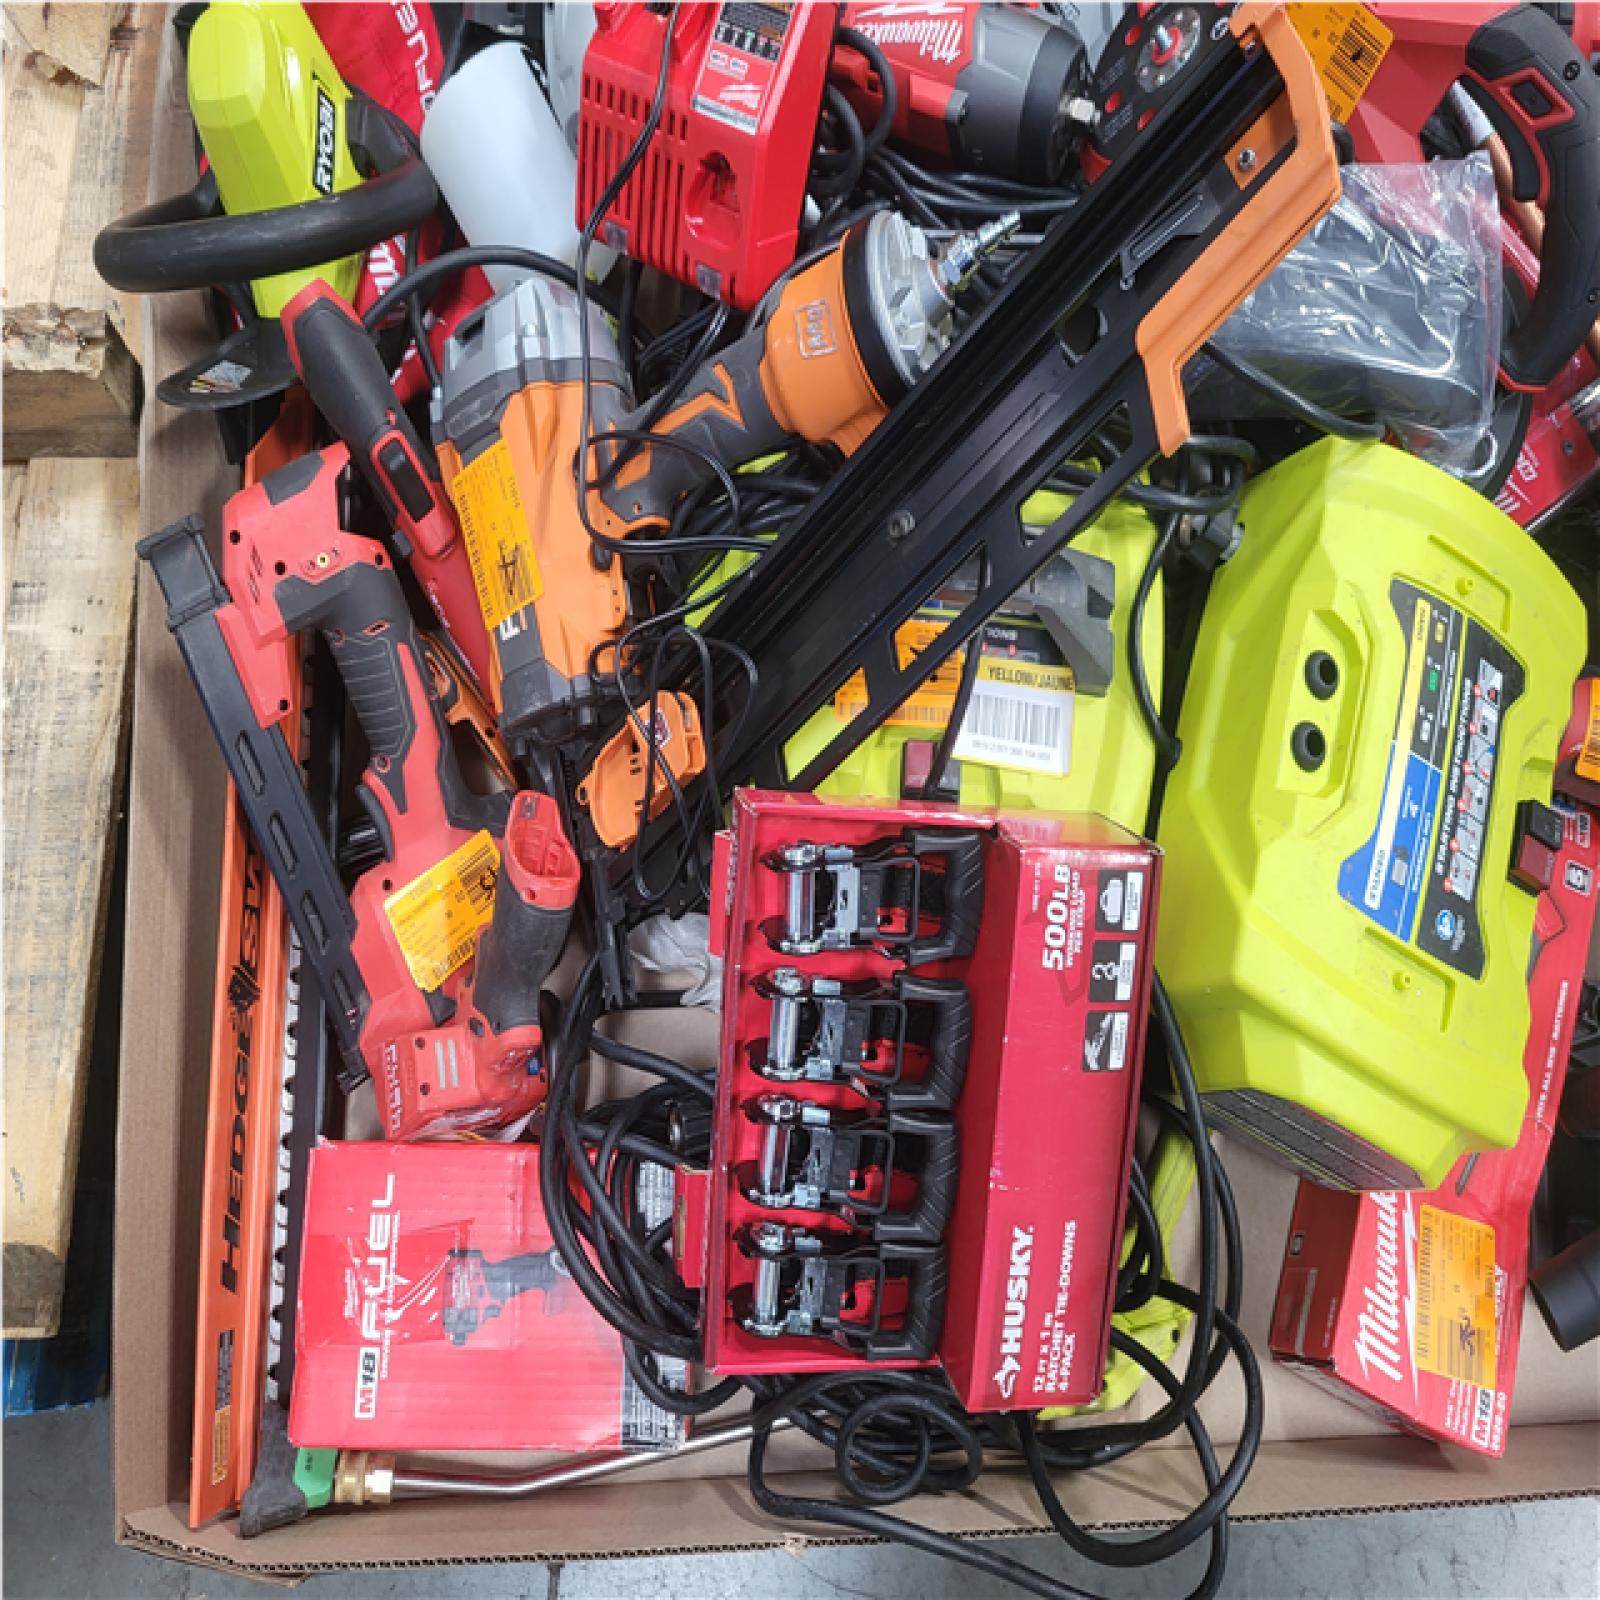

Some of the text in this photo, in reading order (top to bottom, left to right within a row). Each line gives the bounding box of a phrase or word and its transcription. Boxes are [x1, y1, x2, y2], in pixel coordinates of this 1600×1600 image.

[316, 91, 333, 194] RYOBI
[361, 1174, 395, 1341] FUEL
[1044, 1220, 1077, 1392] RATCHET TIE-DOWNS
[1354, 1190, 1402, 1381] Milwauk
[356, 1347, 380, 1419] M18
[1059, 1332, 1076, 1392] 4-PACK
